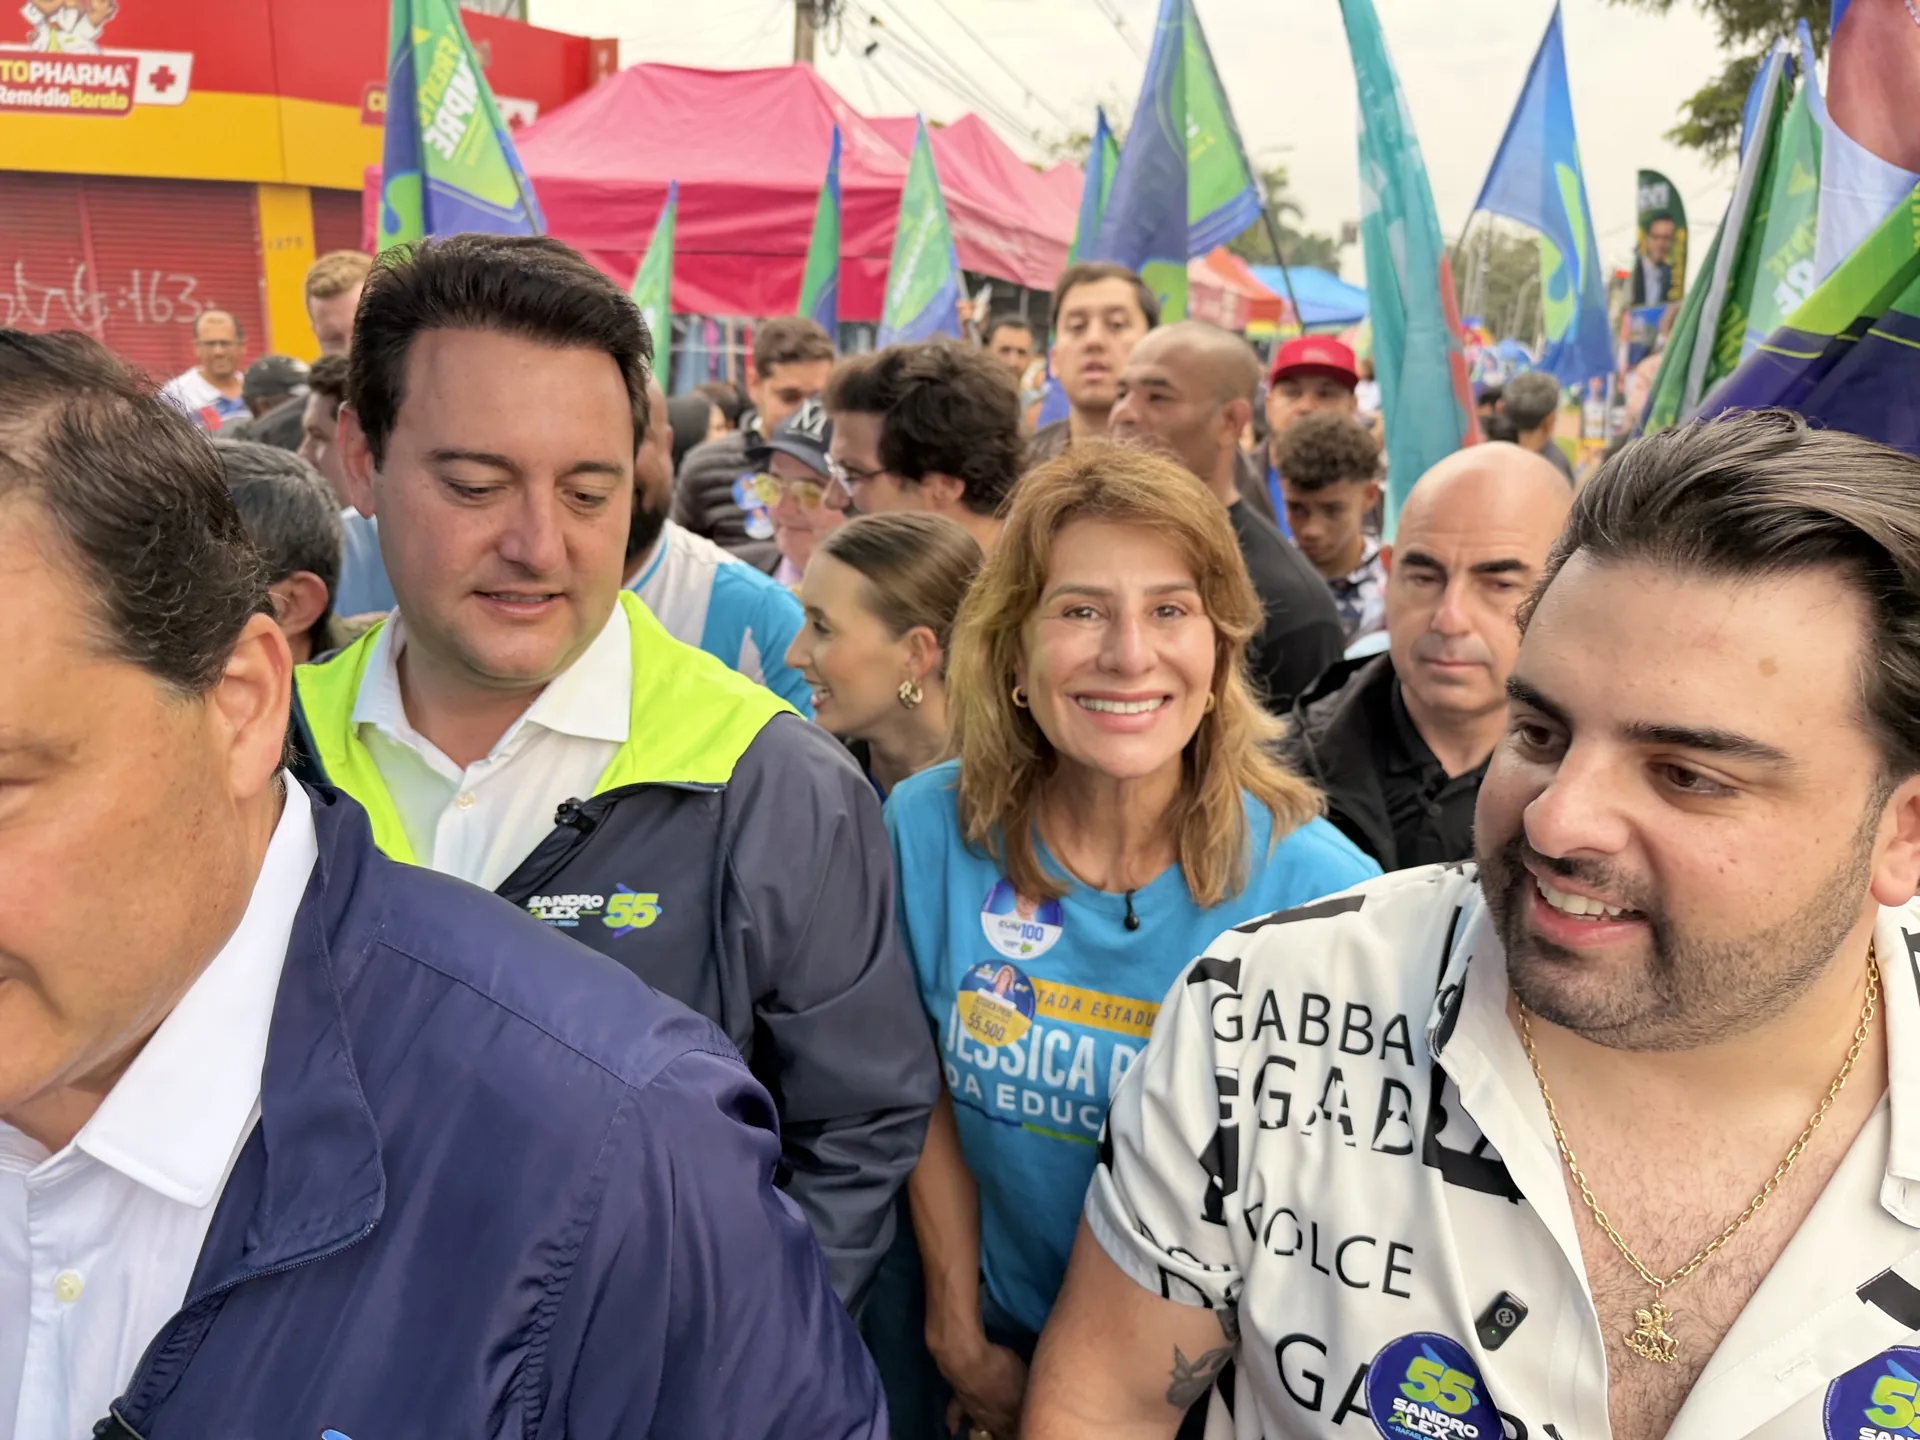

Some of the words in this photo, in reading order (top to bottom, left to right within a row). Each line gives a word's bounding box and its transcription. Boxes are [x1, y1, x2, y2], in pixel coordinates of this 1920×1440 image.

[527, 894, 605, 910] SANDRO
[602, 892, 659, 928] 55
[1020, 922, 1045, 942] 100
[1210, 988, 1415, 1067] GABBA
[946, 1063, 984, 1101] DA
[1399, 1355, 1476, 1415] 55
[1392, 1397, 1480, 1439] SANDRO
